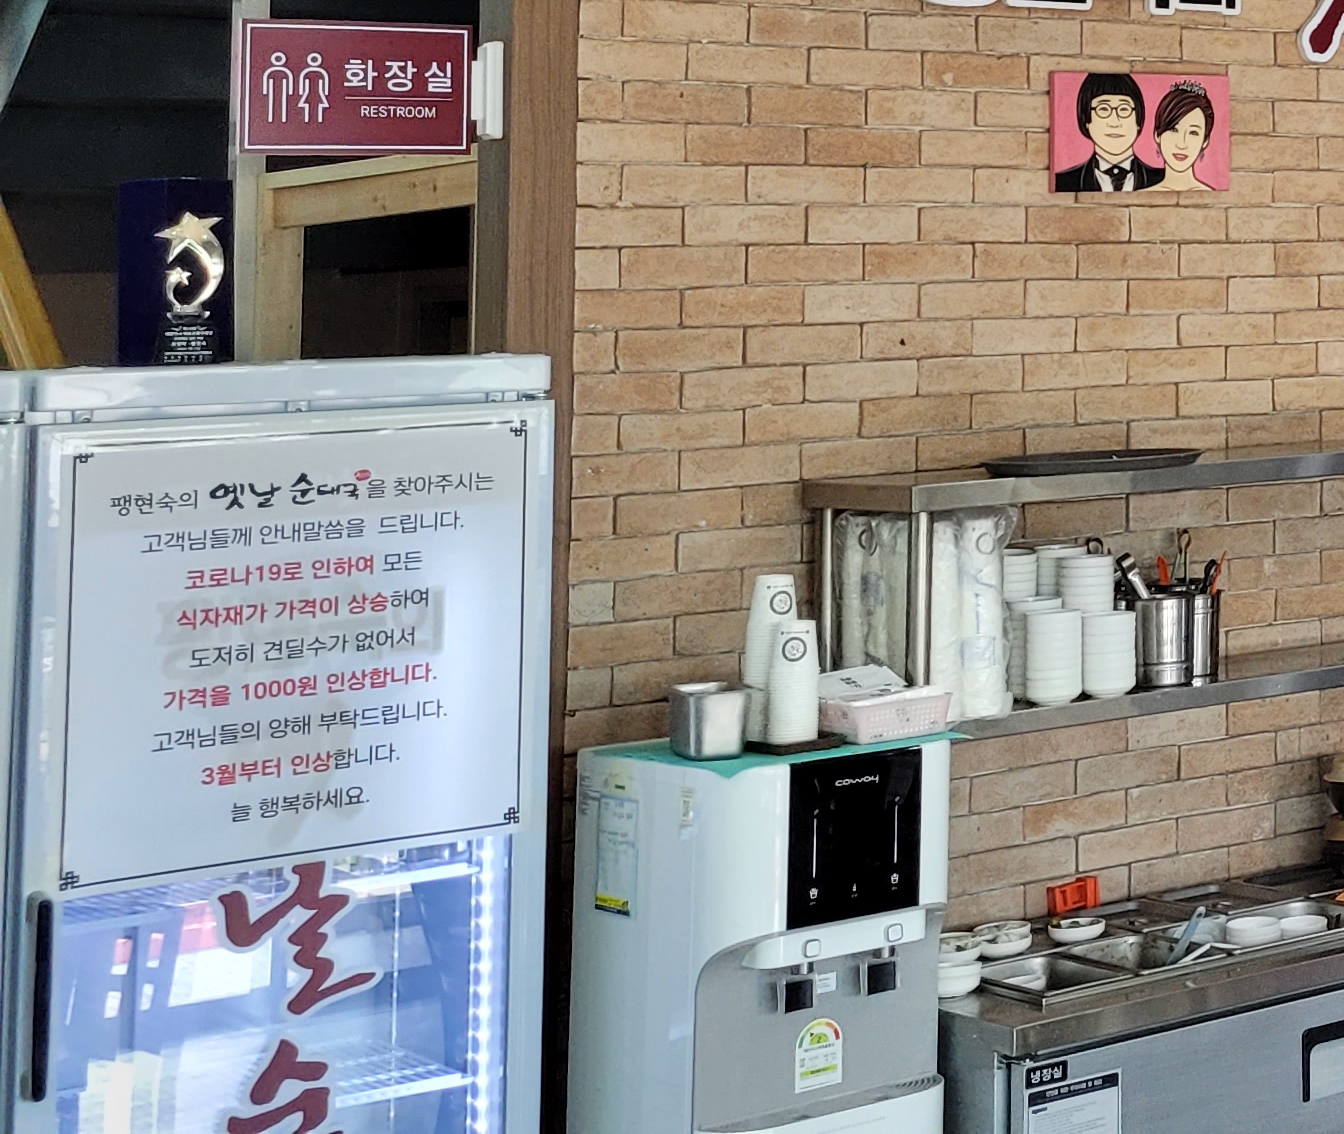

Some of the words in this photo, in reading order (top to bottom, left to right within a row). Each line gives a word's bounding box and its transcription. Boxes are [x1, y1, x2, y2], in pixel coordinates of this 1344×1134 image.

[344, 59, 453, 93] 화장실
[360, 105, 437, 119] RESTROOM
[110, 489, 199, 517] 팽현숙의
[209, 482, 282, 511] 옛날
[393, 472, 495, 497] 찾아주시는
[141, 527, 253, 554] 고객님들께
[259, 517, 366, 545] 안내말씀을
[378, 510, 464, 534] 드립니다.
[184, 562, 304, 590] 코로나19로
[311, 554, 374, 580] 인하여
[382, 551, 423, 572] 모든
[177, 603, 267, 630] 식자재가
[275, 596, 339, 620] 가격이
[347, 587, 430, 615] 상승하여
[189, 642, 254, 669] 도저히
[263, 633, 350, 662] 견딜수가
[355, 627, 416, 652] 없어서
[163, 684, 232, 711] 가격을
[241, 675, 318, 701] 1000원
[327, 663, 438, 694] 인상합니다.
[150, 720, 261, 752] 고객님들의
[269, 716, 311, 739] 양해
[318, 699, 448, 733] 부탁드립니다.
[200, 757, 282, 786] 3월부터
[290, 742, 400, 774] 인상합니다.
[231, 802, 251, 823] 늘
[259, 787, 370, 818] 행복하세요.
[1030, 1065, 1062, 1084] 냉장실
